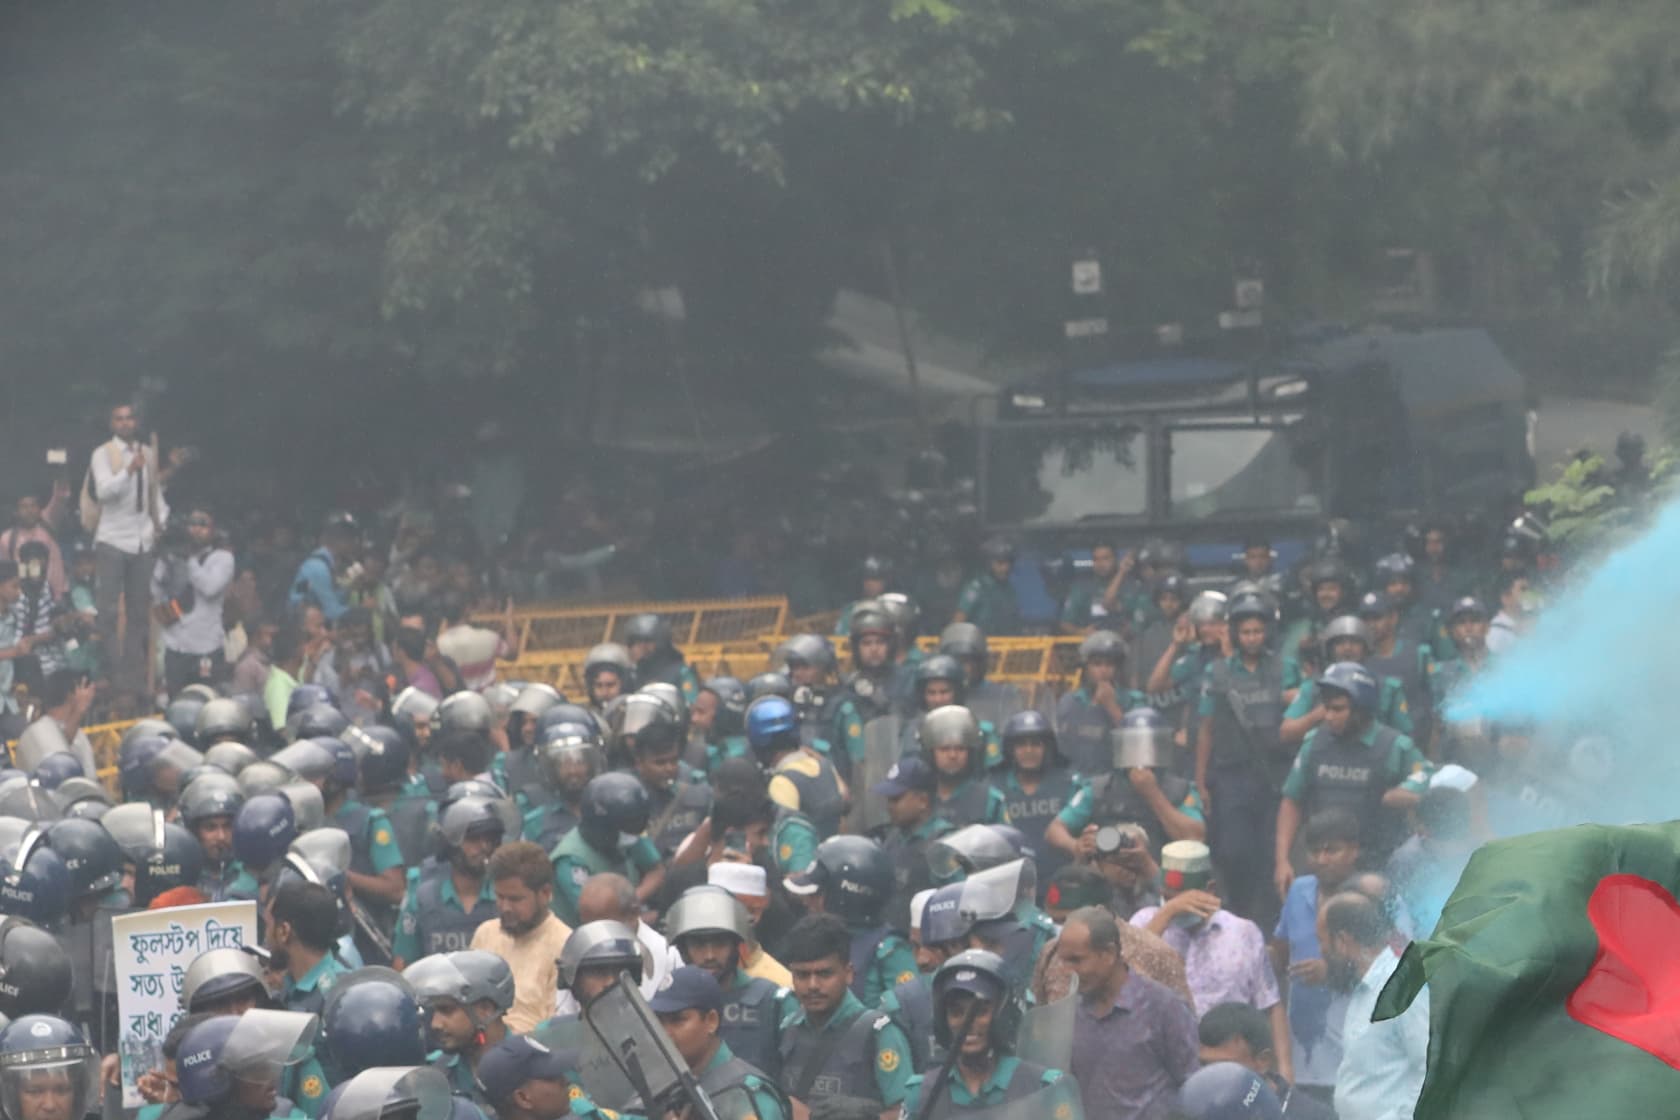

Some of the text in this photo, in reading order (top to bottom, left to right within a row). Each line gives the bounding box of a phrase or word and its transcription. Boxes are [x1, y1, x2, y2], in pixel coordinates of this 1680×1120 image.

[1318, 764, 1370, 781] POLICE
[1009, 798, 1061, 818] OLICE
[149, 864, 181, 876] POLICE
[2, 887, 34, 902] POLICE
[929, 900, 956, 913] POLICE
[129, 924, 200, 963] ফুলস্টপ
[0, 982, 19, 998] LICE
[129, 973, 164, 997] সত্য
[723, 1003, 759, 1022] CE
[183, 1050, 212, 1068] POLICE
[1243, 1079, 1262, 1107] POLICE
